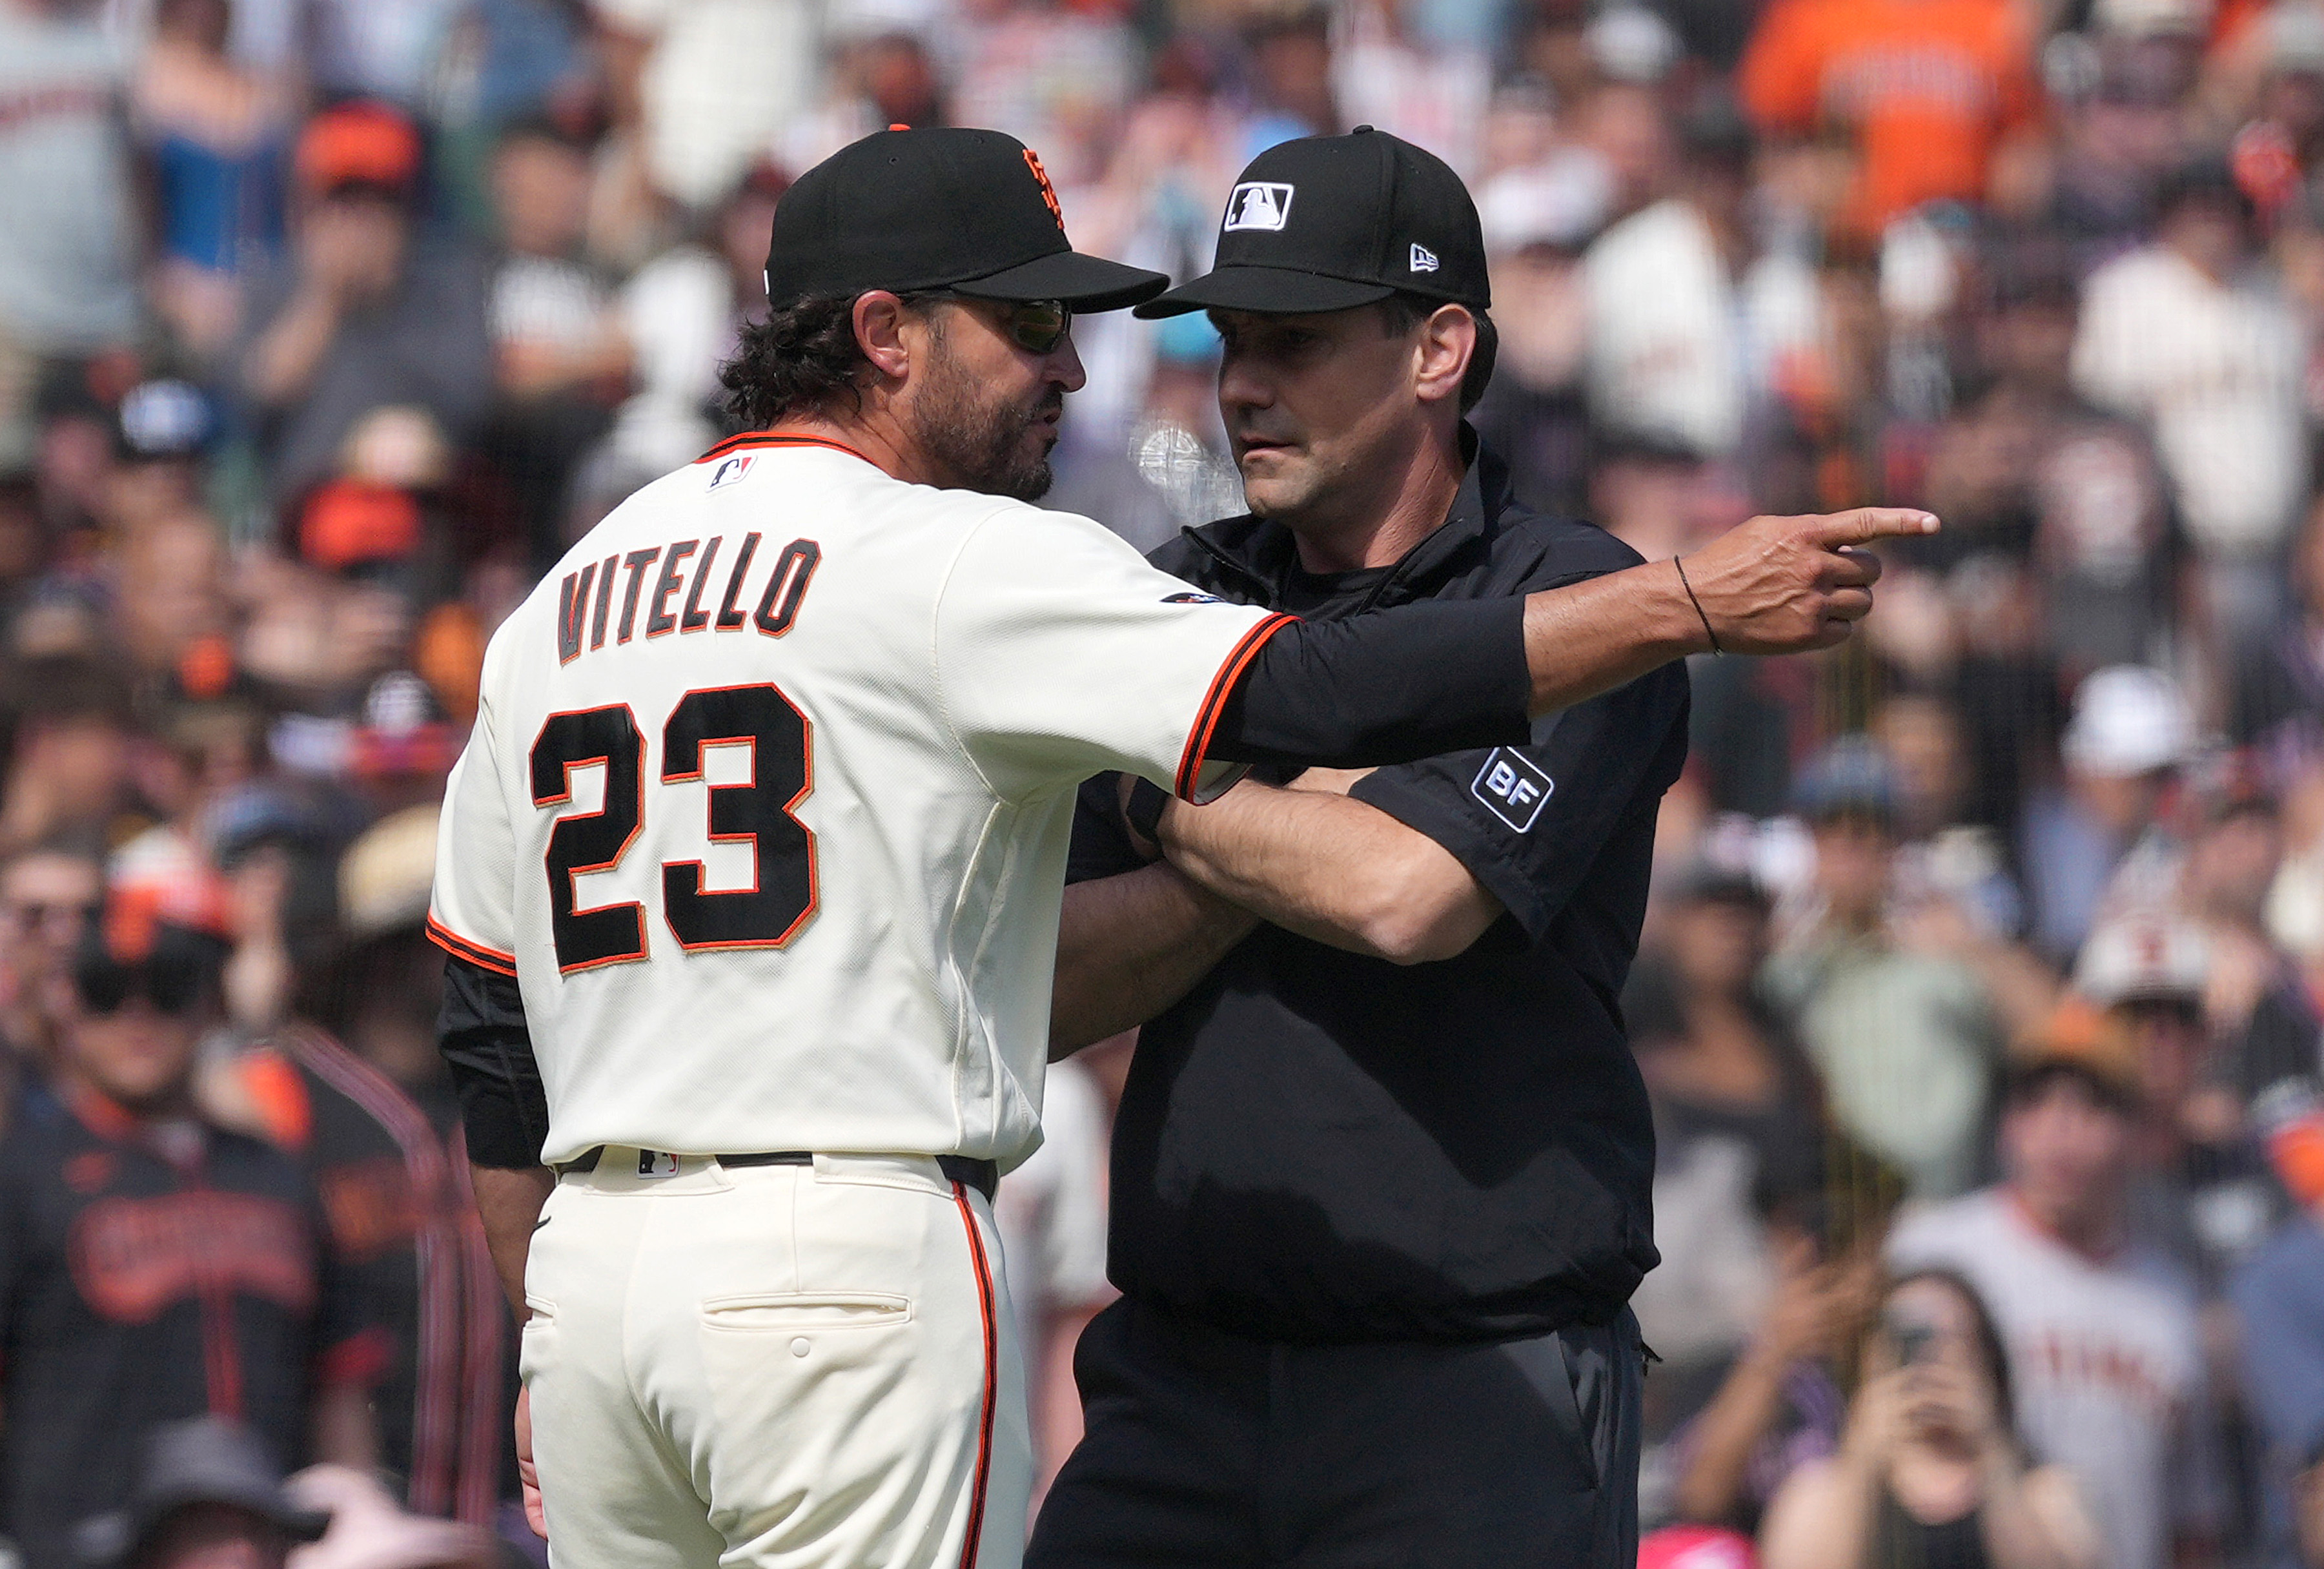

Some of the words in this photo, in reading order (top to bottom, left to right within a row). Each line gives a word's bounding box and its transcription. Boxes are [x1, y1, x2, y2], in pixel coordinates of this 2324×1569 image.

[558, 532, 821, 666] VITELLO
[529, 682, 821, 976] 23
[1485, 761, 1540, 806] BF
